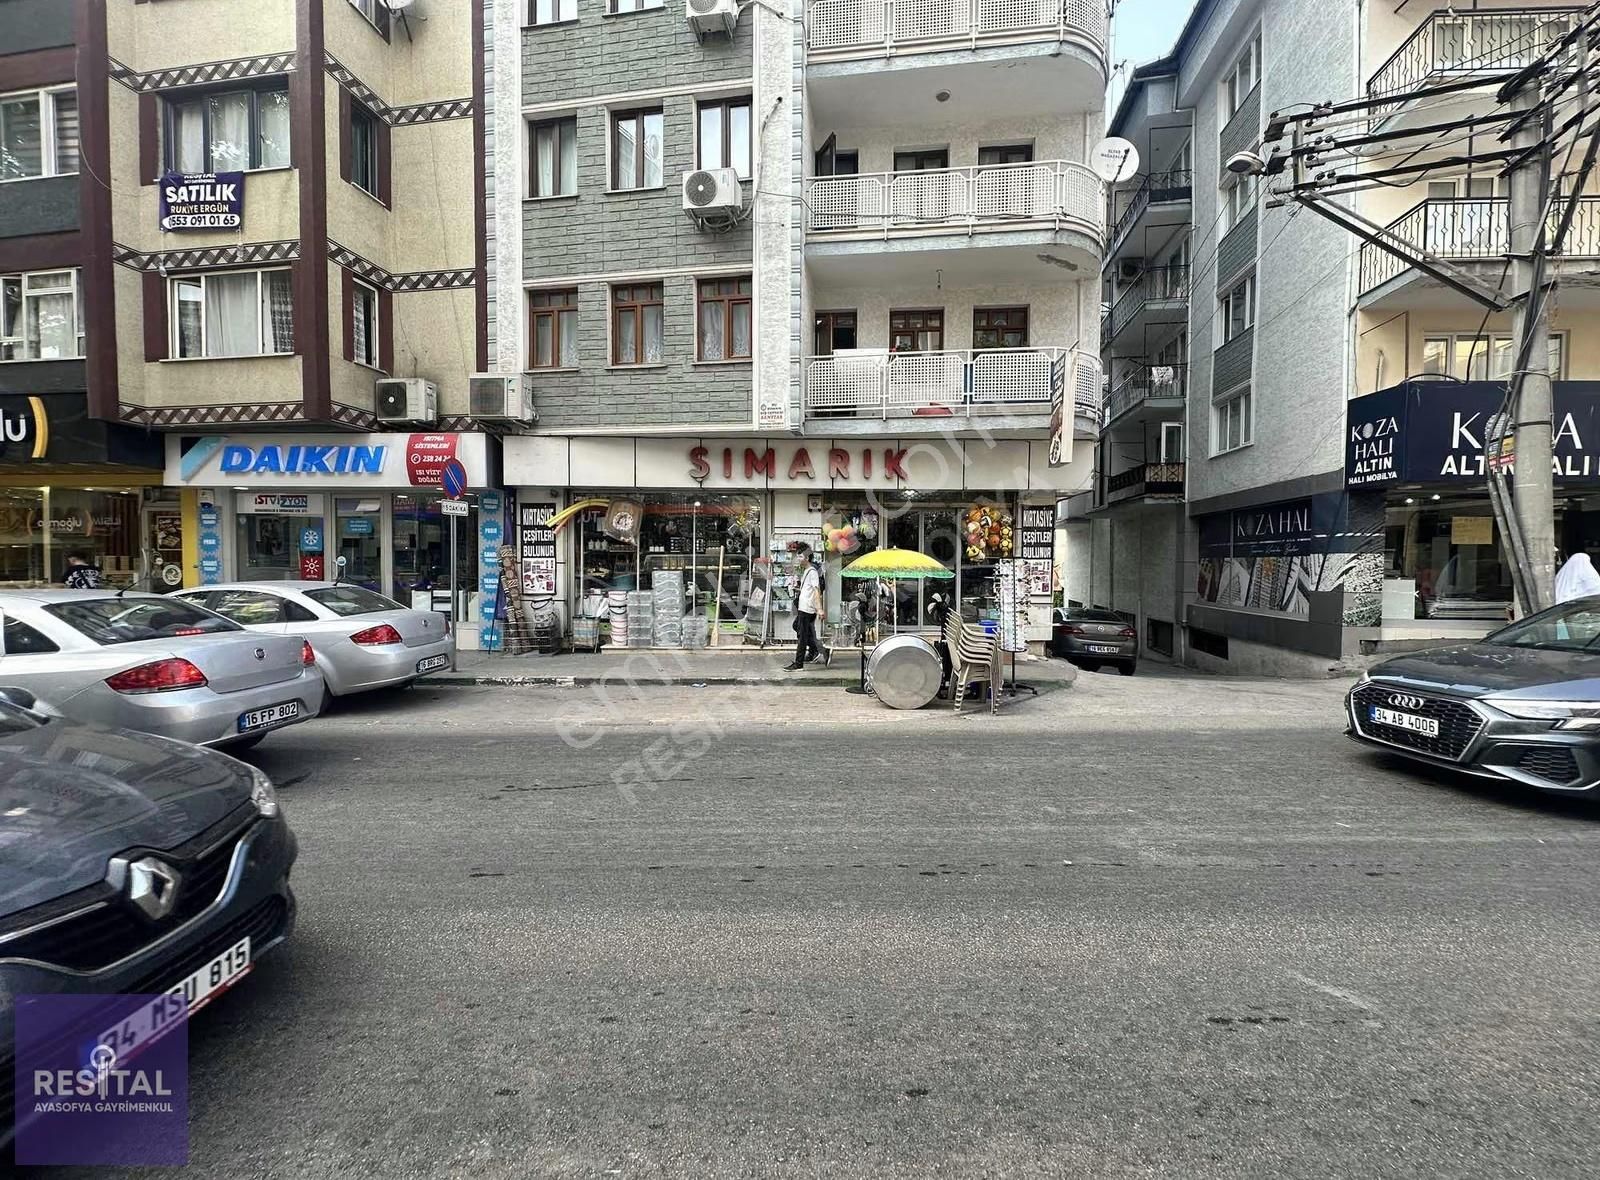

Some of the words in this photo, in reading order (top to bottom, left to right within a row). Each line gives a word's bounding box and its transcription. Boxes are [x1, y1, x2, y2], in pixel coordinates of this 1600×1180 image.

[165, 183, 237, 203] SATILIK
[200, 202, 229, 213] ERGÜN
[190, 215, 206, 225] 091
[208, 215, 220, 225] 01
[222, 215, 236, 225] 65
[220, 445, 386, 473] DAIKIN
[1355, 437, 1393, 460] HALI
[1354, 456, 1393, 475] ALTIN
[523, 545, 554, 557] BULUNUR
[246, 714, 258, 725] 16
[260, 709, 275, 722] FP
[278, 703, 297, 717] 802
[1376, 709, 1387, 722] 34
[1392, 712, 1403, 726] AB
[1408, 716, 1435, 732] 4006
[152, 977, 198, 1031] MSU
[208, 942, 247, 988] 815
